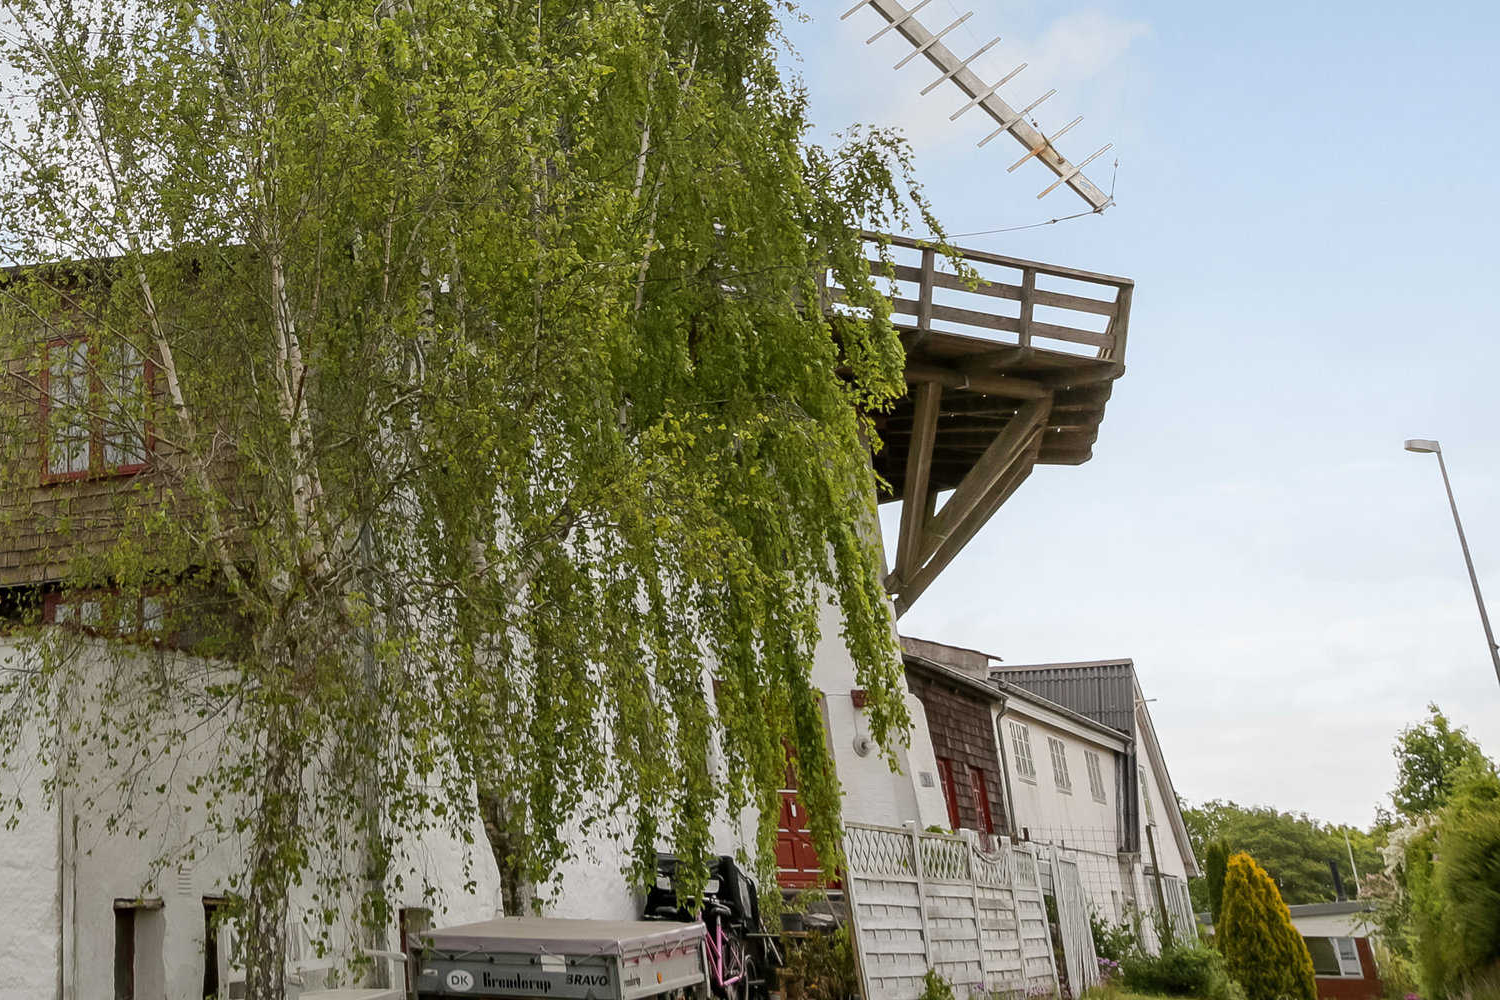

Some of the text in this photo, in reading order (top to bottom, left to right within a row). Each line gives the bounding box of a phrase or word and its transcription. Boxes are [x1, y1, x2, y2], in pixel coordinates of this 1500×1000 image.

[451, 975, 469, 986] DK
[482, 971, 552, 993] Brenderup
[566, 973, 609, 986] BRAVO
